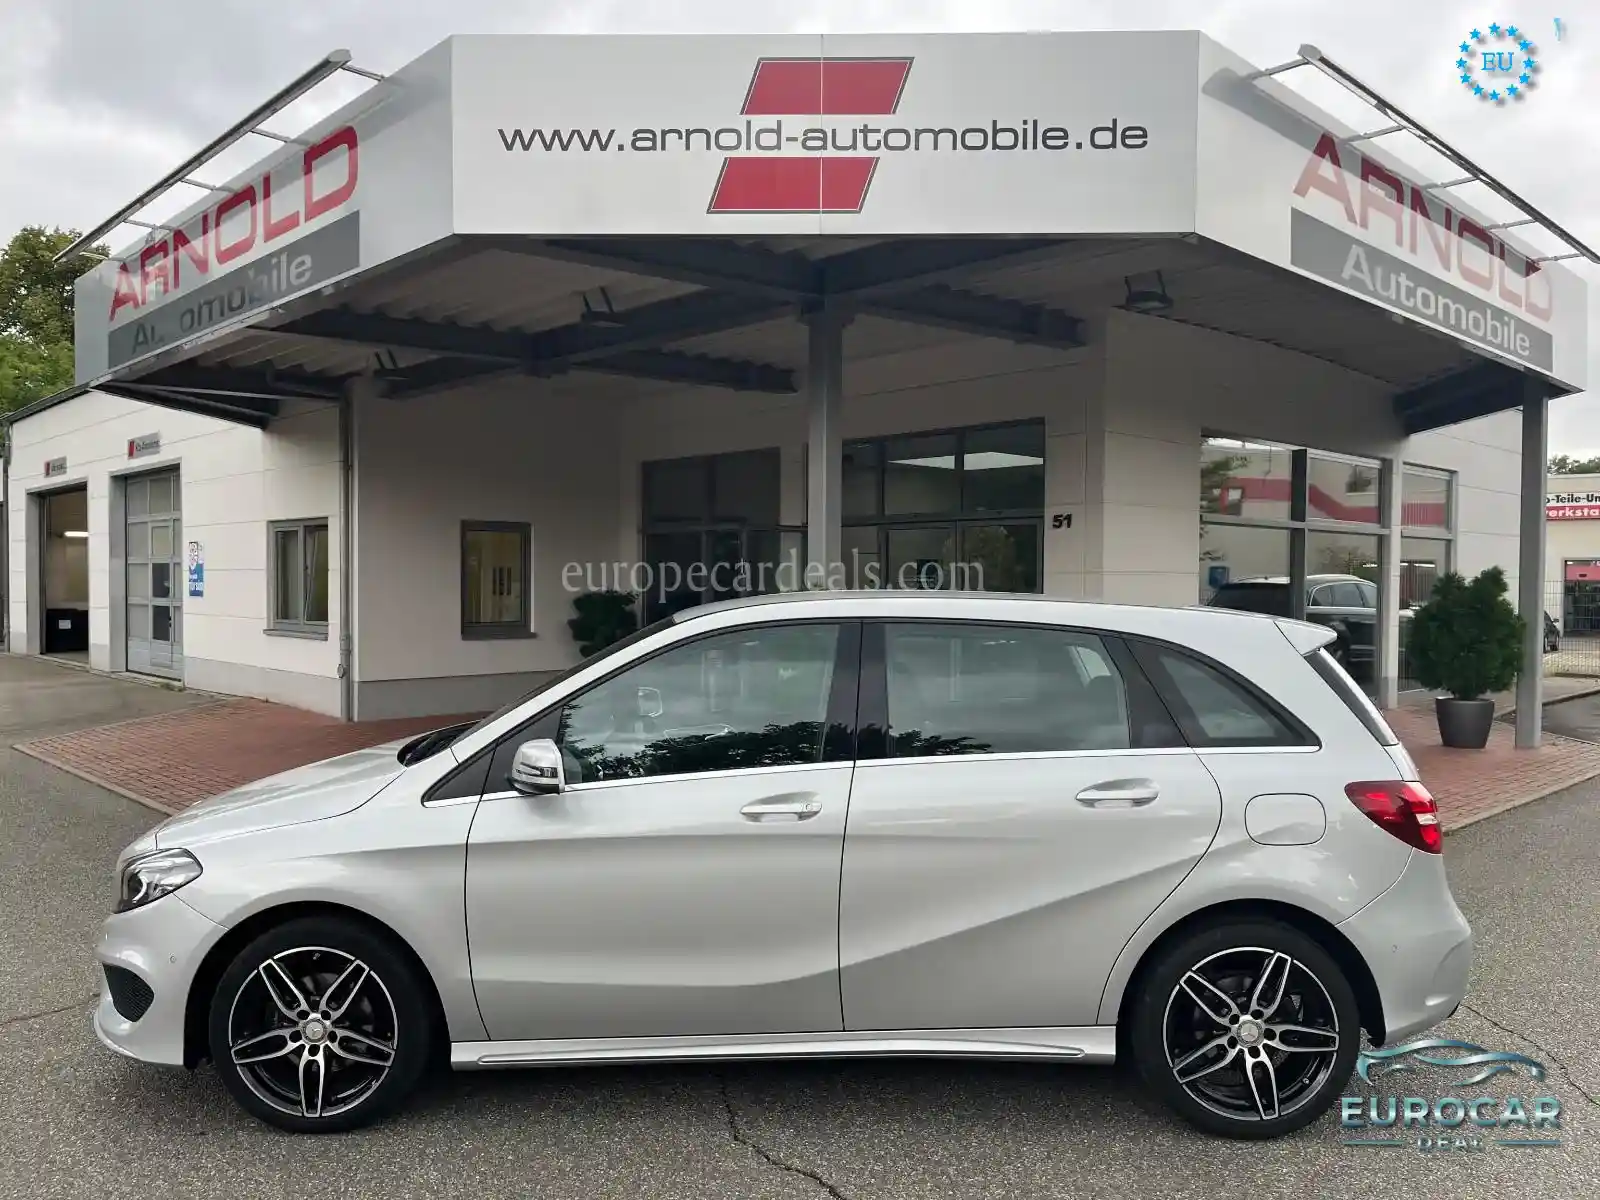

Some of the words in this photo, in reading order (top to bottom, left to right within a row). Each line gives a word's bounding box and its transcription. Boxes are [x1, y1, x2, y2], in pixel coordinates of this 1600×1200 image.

[498, 118, 1149, 153] www.arnold-automobile.de
[109, 124, 359, 322] ARNOLD
[1293, 131, 1553, 323] ARNOLD
[1341, 244, 1531, 356] Automobile
[1052, 513, 1073, 529] 51
[1546, 506, 1600, 517] erksta
